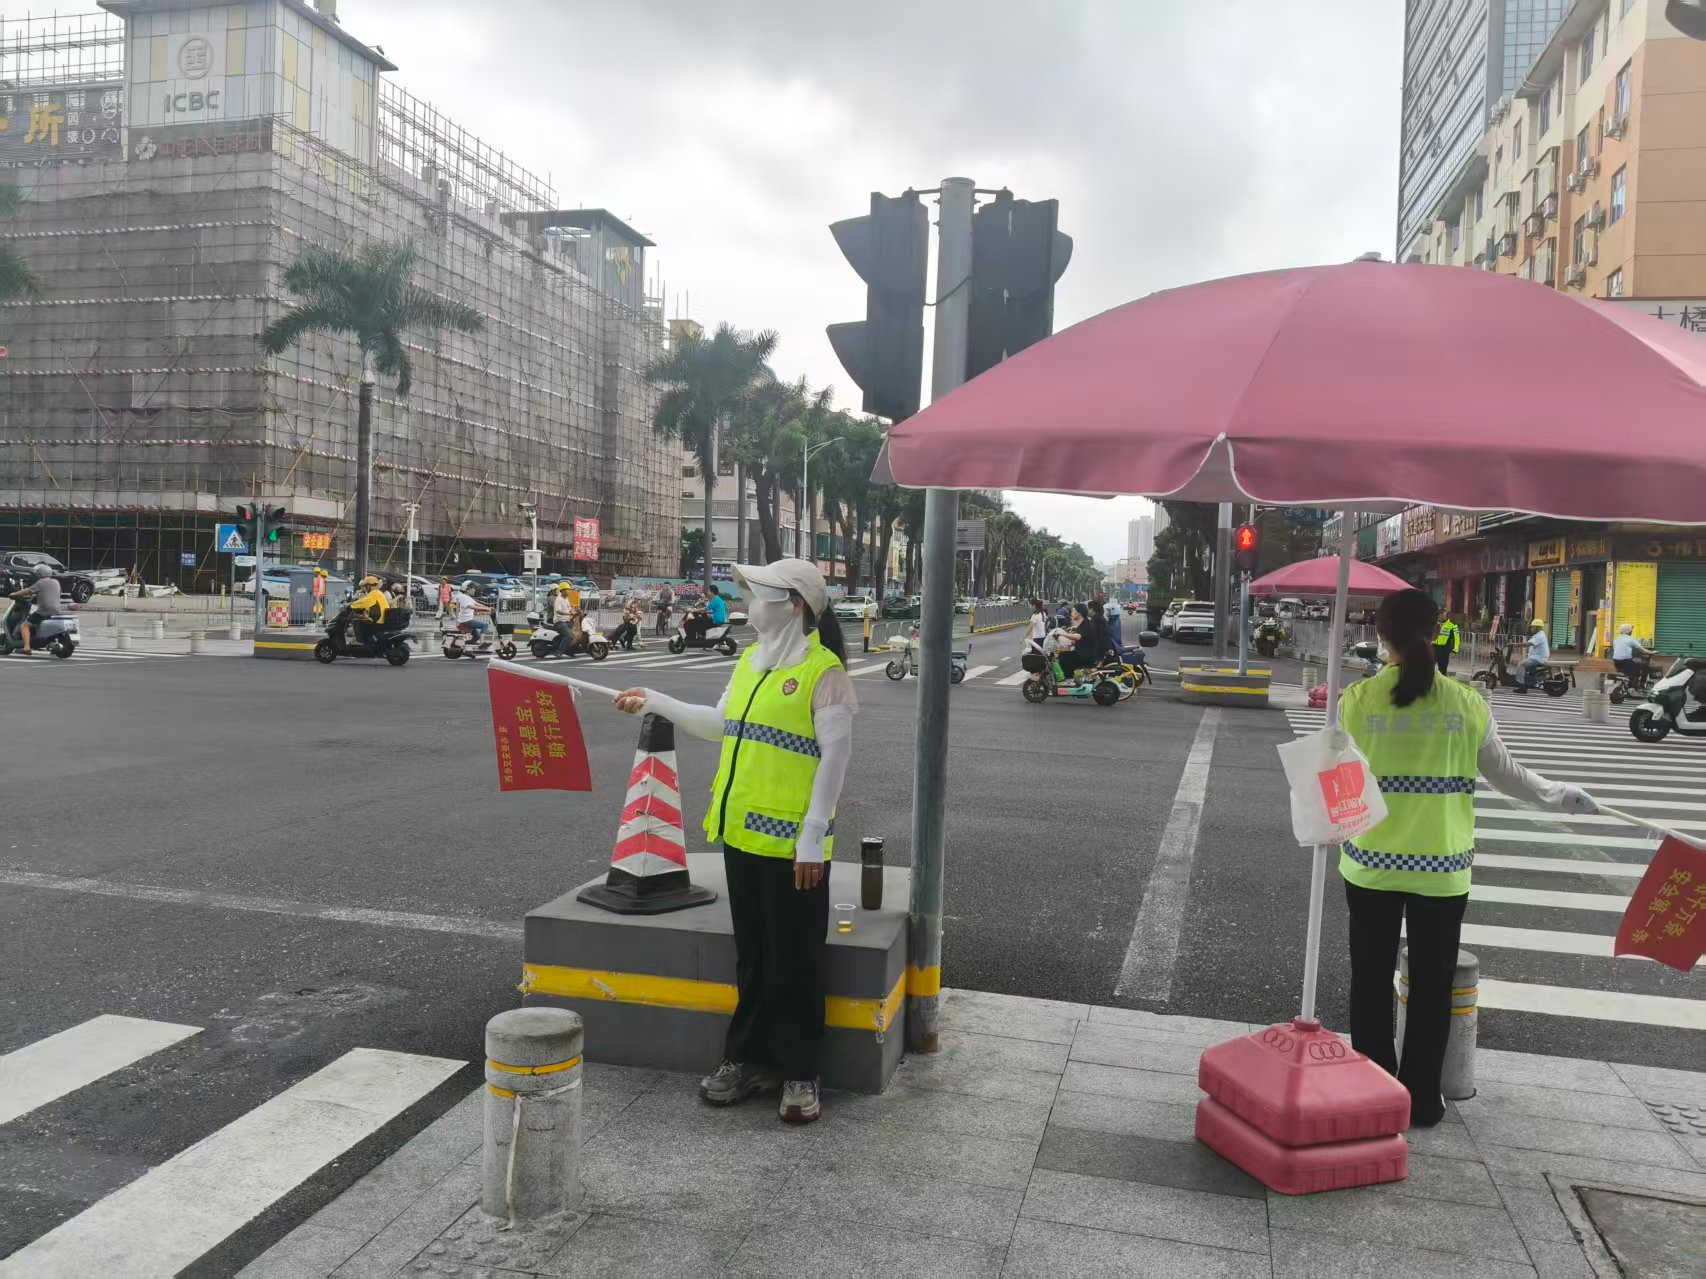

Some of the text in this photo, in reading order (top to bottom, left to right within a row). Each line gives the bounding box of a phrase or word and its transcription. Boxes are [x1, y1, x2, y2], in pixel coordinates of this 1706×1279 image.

[165, 90, 220, 113] ICBC
[535, 689, 567, 760] 骑行戴好
[1631, 867, 1693, 944] 安全第一条
